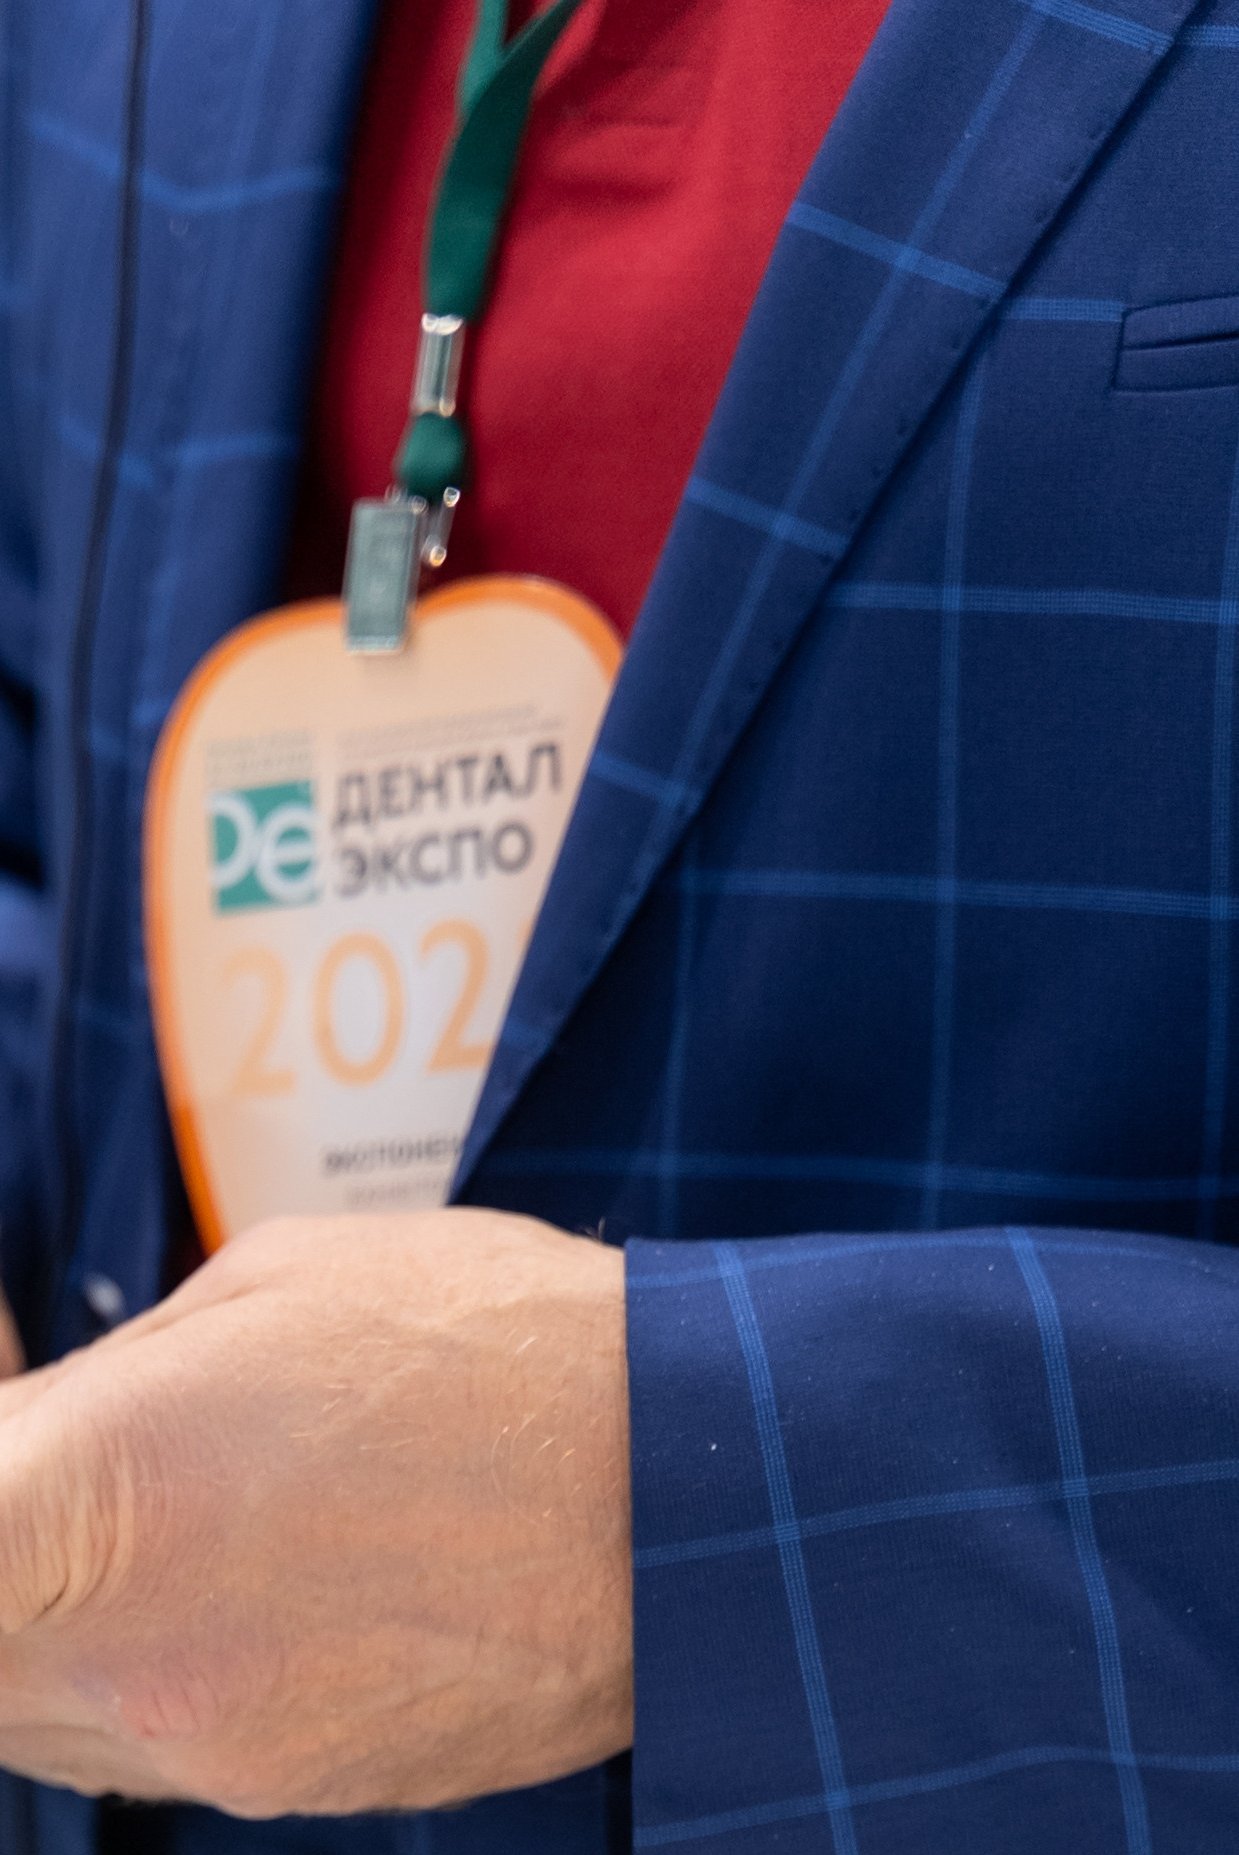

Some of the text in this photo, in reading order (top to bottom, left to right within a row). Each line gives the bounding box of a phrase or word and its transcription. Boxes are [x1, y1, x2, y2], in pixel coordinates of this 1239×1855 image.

[333, 741, 562, 829] ДЕНТАЛ
[334, 820, 534, 899] ЭКСПО
[219, 916, 533, 1100] 202
